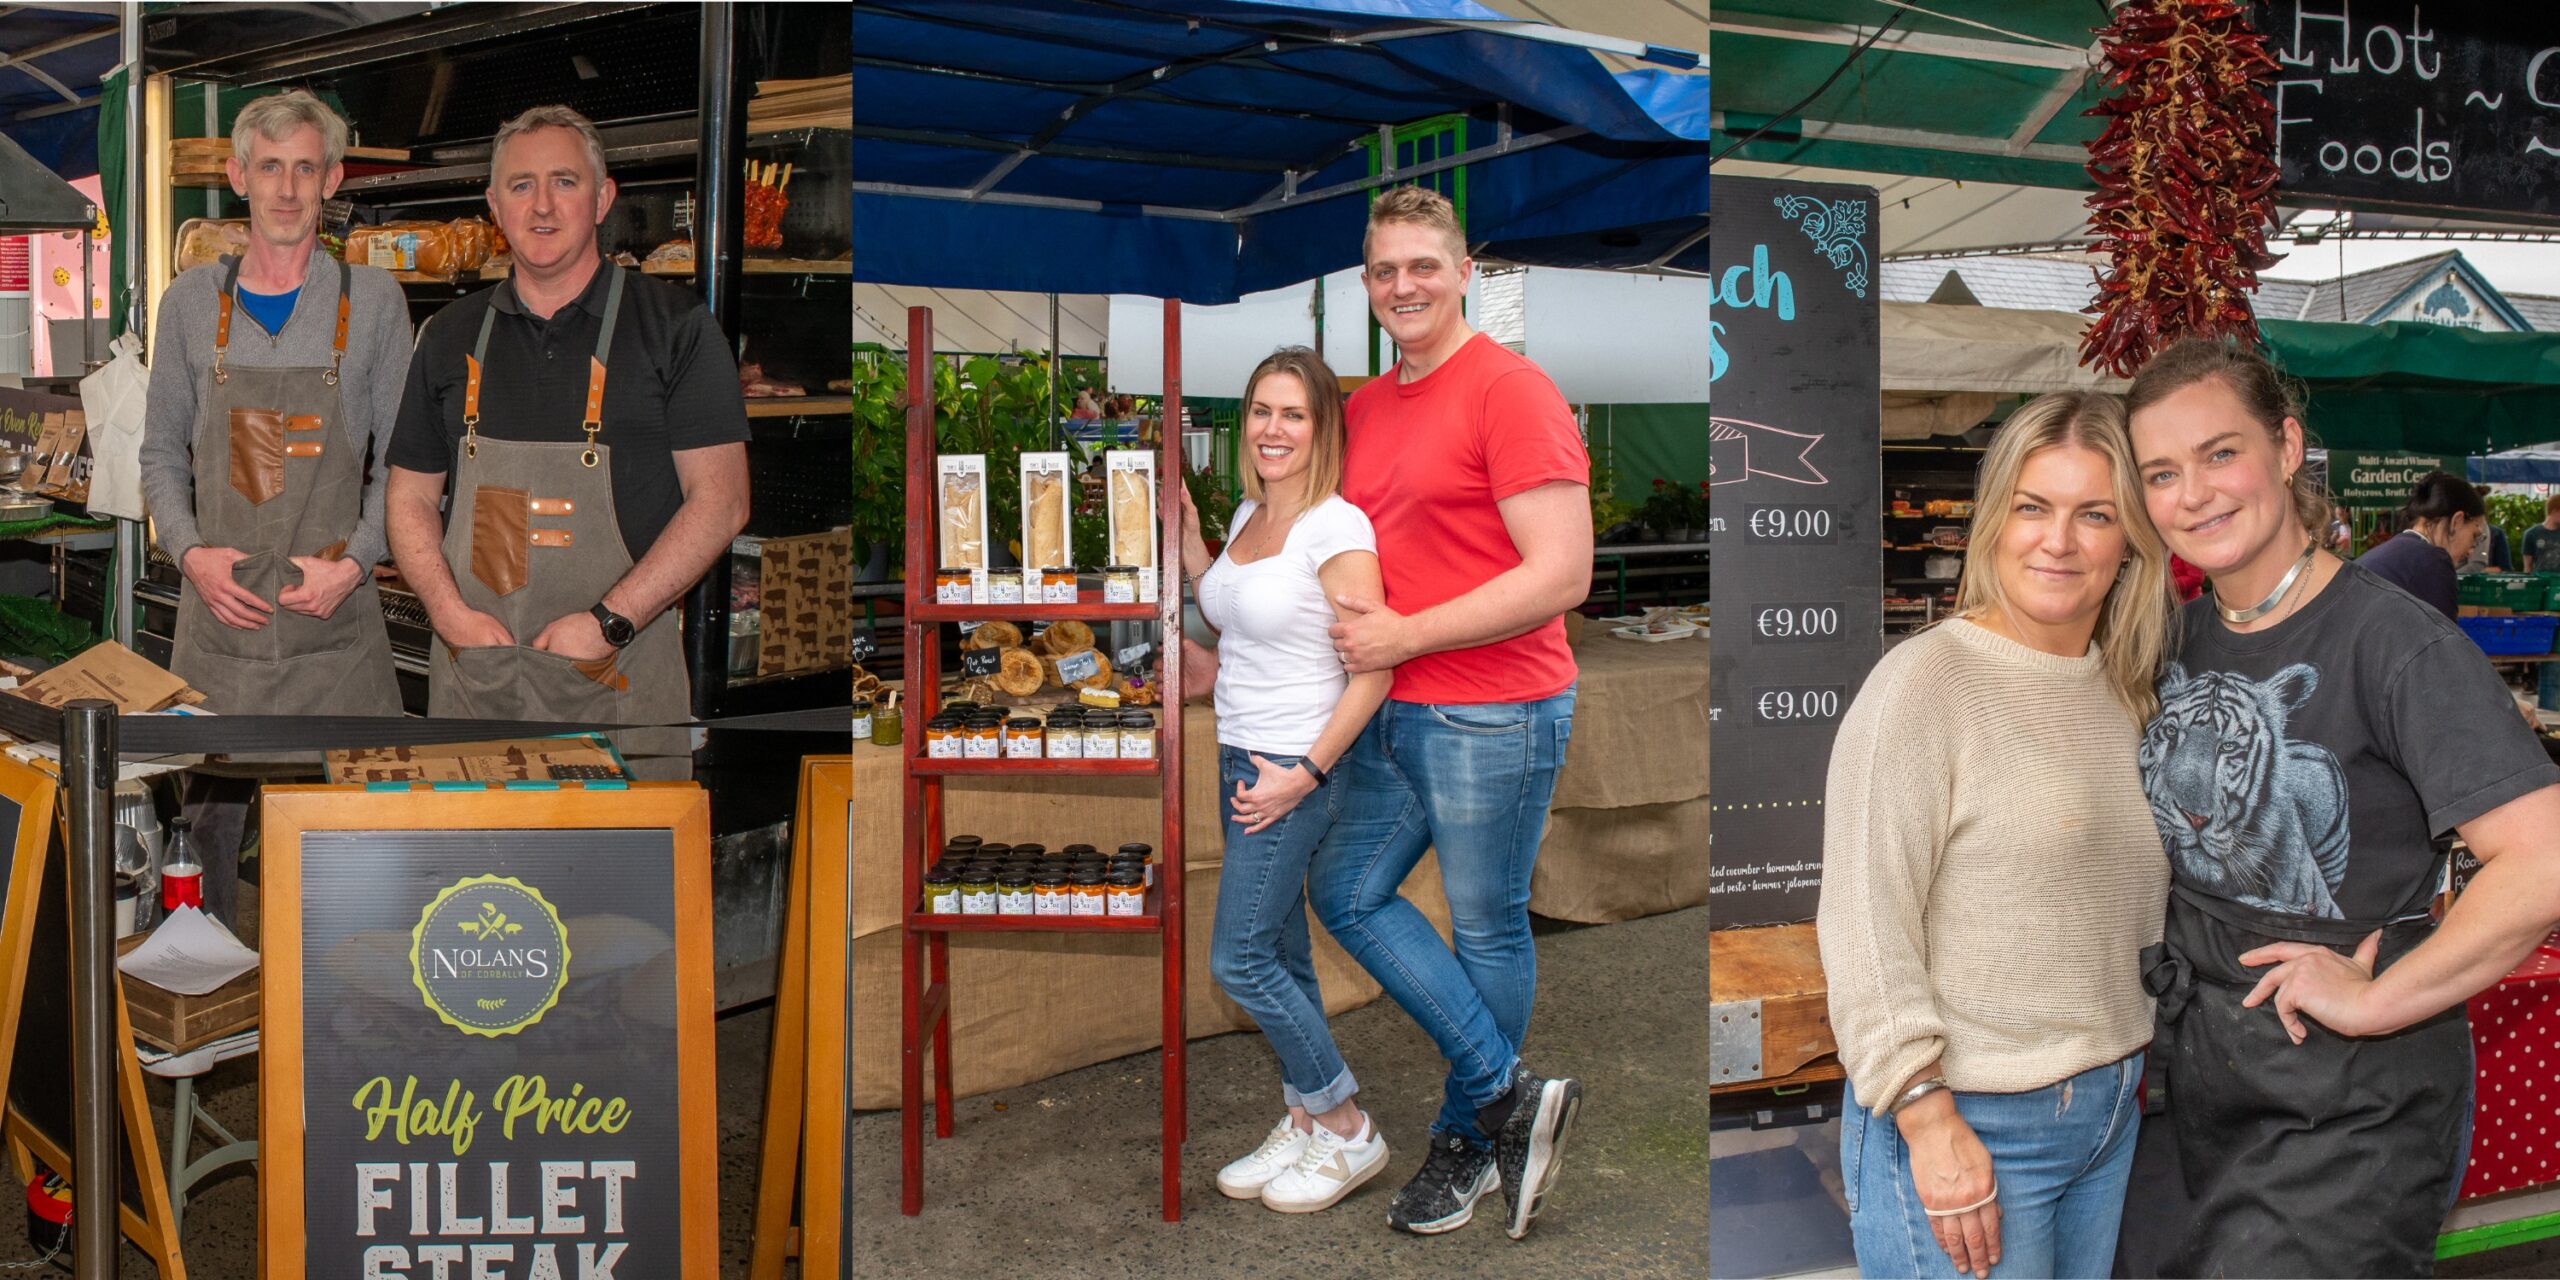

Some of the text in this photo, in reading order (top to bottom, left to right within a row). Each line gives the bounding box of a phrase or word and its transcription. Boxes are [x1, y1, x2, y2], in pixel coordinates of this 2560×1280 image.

[2279, 0, 2441, 80] Hot
[2273, 79, 2452, 183] Foods
[1710, 244, 1795, 321] ch
[4, 407, 25, 432] Oven
[2350, 468, 2401, 484] Garden
[1749, 509, 1830, 537] €9.00
[1757, 608, 1837, 637] €9.00
[1757, 690, 1837, 719] €9.00
[1726, 863, 1760, 877] cucumber
[1766, 860, 1804, 874] homemade
[1727, 880, 1747, 894] pesto
[1752, 880, 1781, 891] hummus
[432, 948, 549, 979] NOLANS
[461, 970, 522, 979] OF CORBALLY
[352, 1074, 632, 1156] Half Price
[355, 1161, 636, 1236] FILLET
[363, 1242, 629, 1280] STEAK
